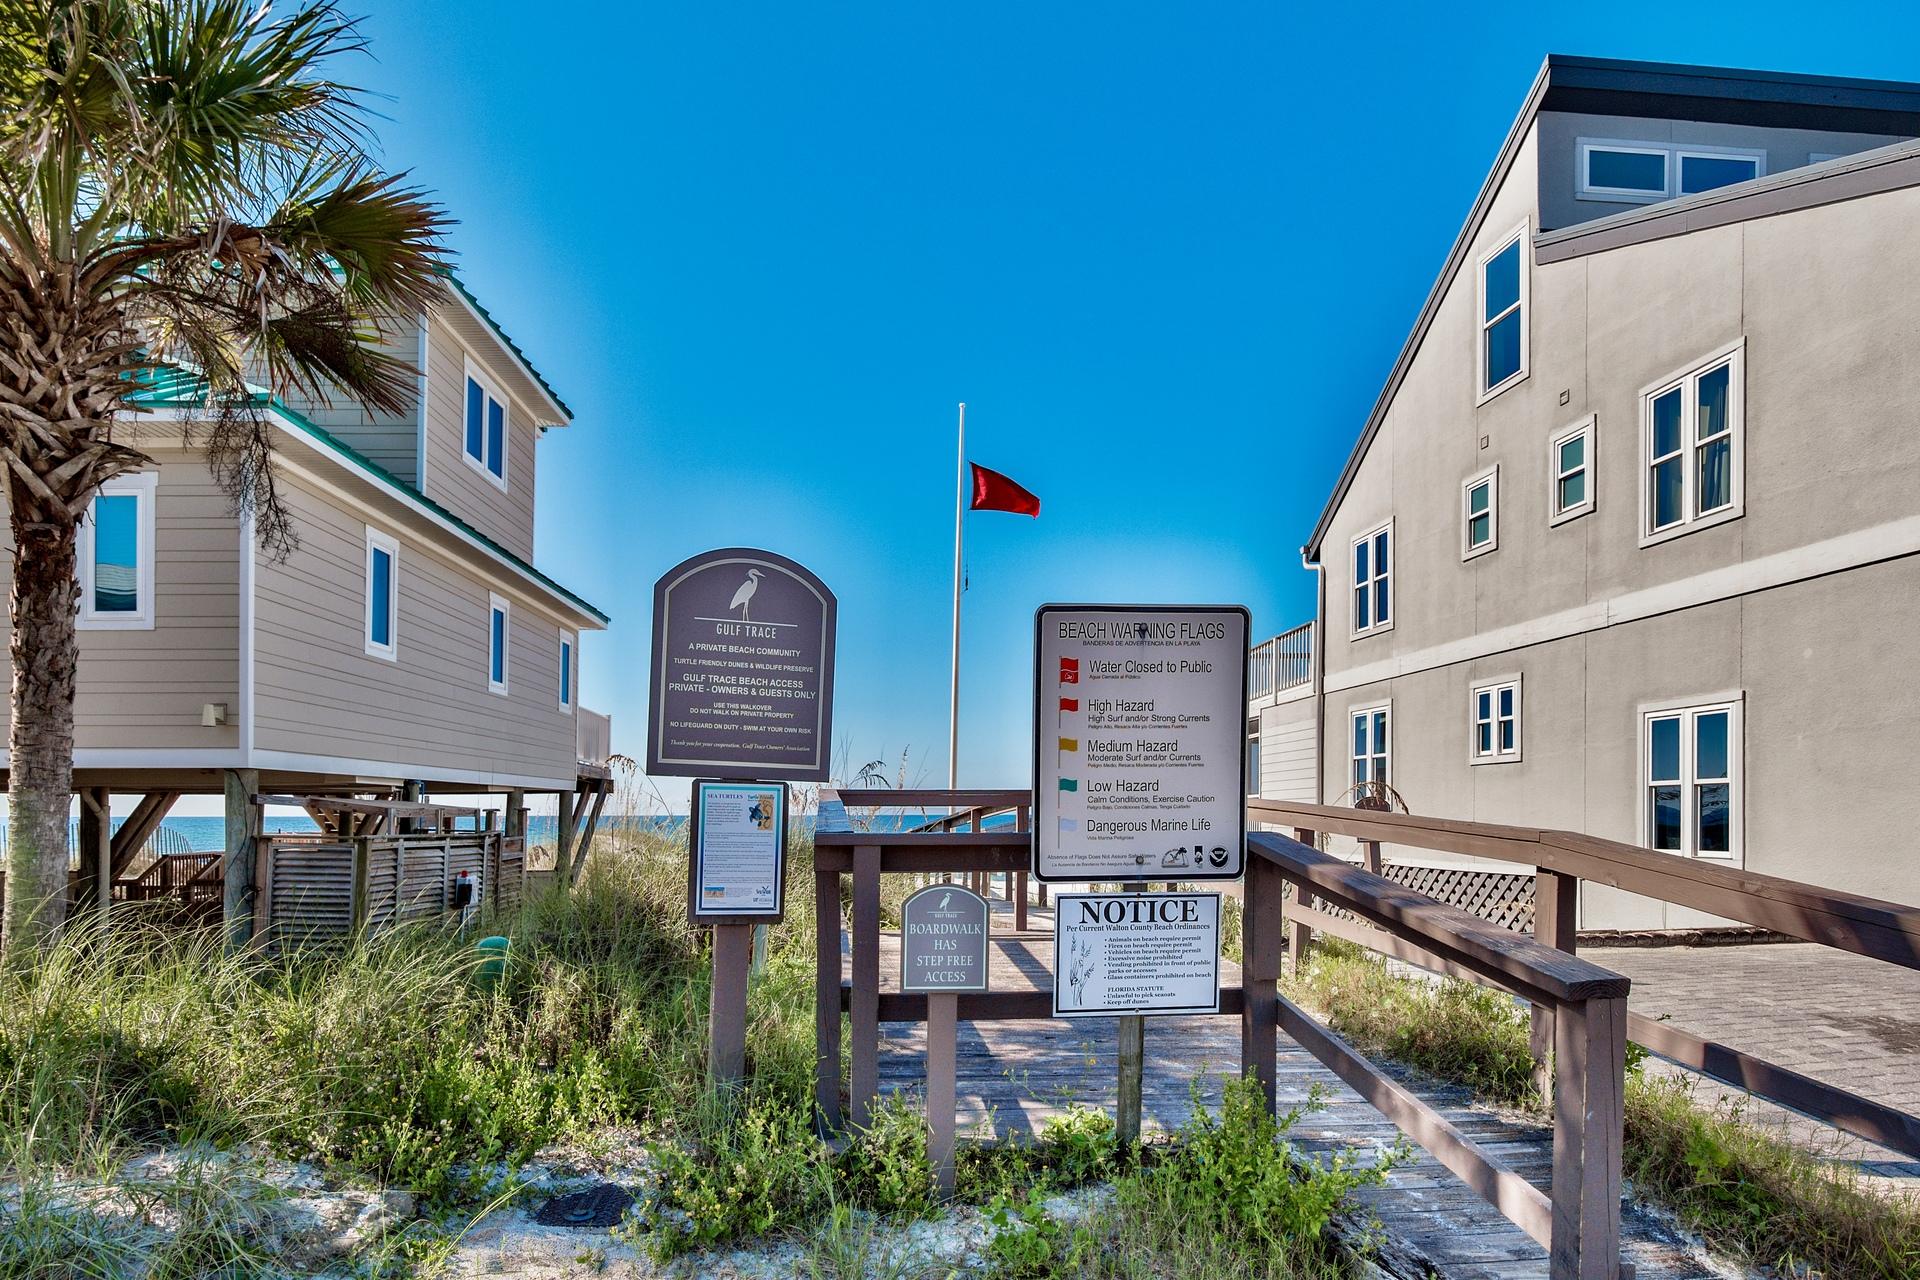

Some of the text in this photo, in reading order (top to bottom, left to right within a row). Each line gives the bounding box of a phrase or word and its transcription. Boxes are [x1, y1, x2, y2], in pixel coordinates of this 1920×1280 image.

[716, 624, 776, 639] GULF TRACE
[1058, 622, 1226, 639] BEACH WARNING FLAGS
[696, 644, 727, 652] PRIVATE
[728, 646, 755, 654] BEACH
[756, 648, 800, 657] COMMUNITY
[698, 659, 727, 668] FRIENDLY
[755, 663, 782, 671] WILDLIFE
[783, 664, 813, 673] PRESERVE
[1090, 660, 1213, 672] Water Closed to Public
[683, 674, 803, 689] GULF TRACE BEACH ACCESS
[669, 683, 704, 694] PRIVATE
[711, 686, 748, 696] OWNERS
[751, 688, 757, 696] &
[759, 688, 792, 698] GUESTS
[794, 690, 815, 699] ONLY
[1088, 699, 1154, 715] High Hazard
[1087, 714, 1105, 724] High
[1151, 714, 1176, 724] Strong
[1087, 740, 1178, 752] Medium Hazard
[1088, 779, 1159, 792] Low Hazard
[1086, 819, 1210, 834] Dangerous Marine Life
[1079, 900, 1199, 924] NOTICE
[910, 924, 980, 934] BOARDWALK
[1130, 924, 1152, 933] County
[934, 939, 956, 950] HAS
[917, 955, 972, 966] STEP FREE
[925, 971, 965, 982] ACCESS
